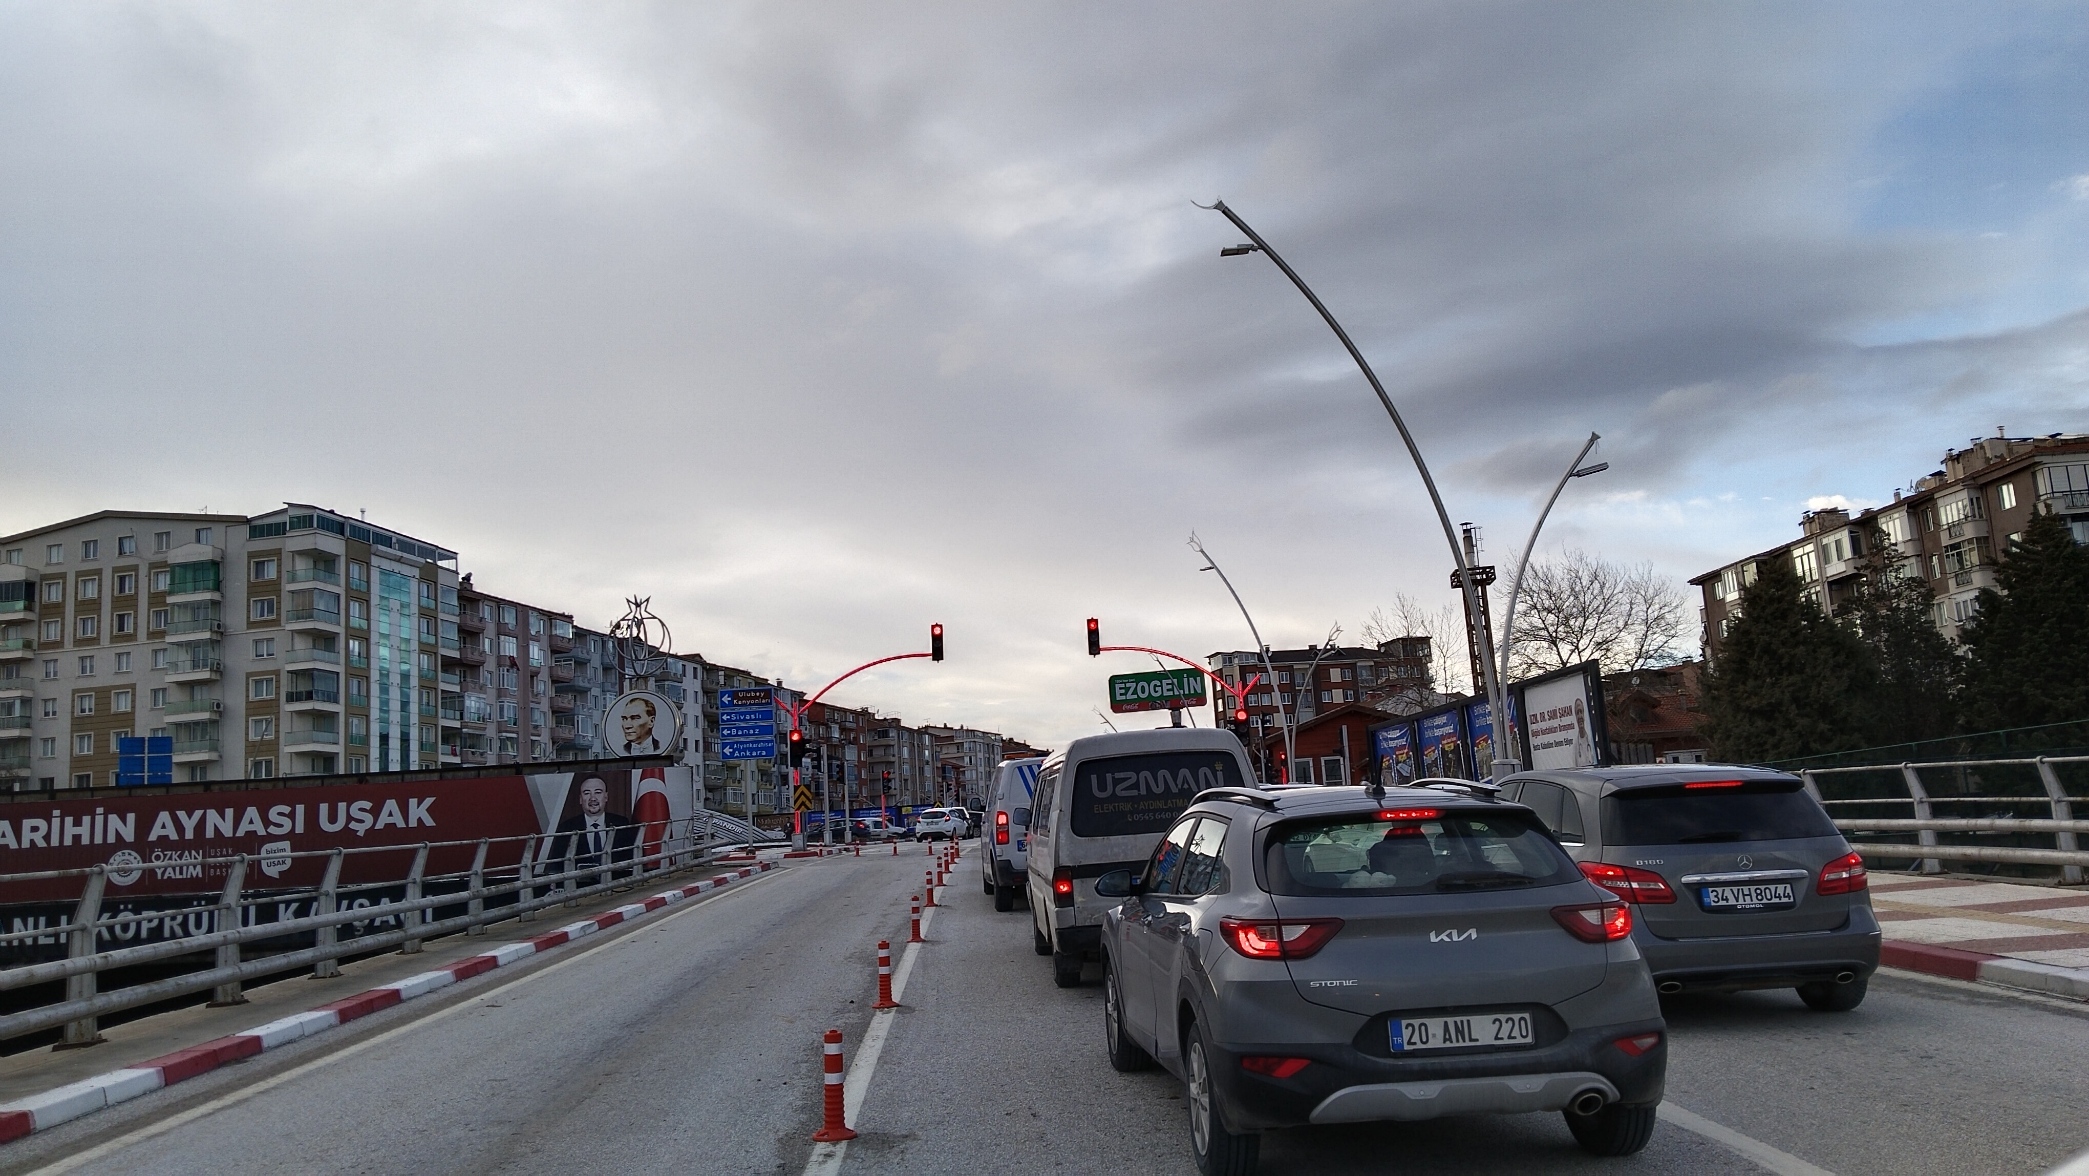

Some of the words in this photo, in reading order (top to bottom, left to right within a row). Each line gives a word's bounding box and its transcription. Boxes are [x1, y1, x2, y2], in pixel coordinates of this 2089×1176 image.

[1115, 674, 1202, 700] EZOGELİN
[1090, 767, 1225, 798] UZMAN
[0, 807, 136, 849] ARİHİN
[148, 804, 305, 841] AYNASI
[319, 797, 437, 837] UŞAK
[152, 848, 202, 863] ÖZKAN
[266, 847, 287, 855] bizim
[156, 864, 202, 880] YALIM
[1710, 889, 1730, 904] 34
[1730, 887, 1751, 902] VH
[1755, 885, 1792, 902] 8044
[1429, 928, 1478, 943] KIA
[1310, 979, 1358, 988] STONIC
[1404, 1022, 1430, 1046] 20
[1442, 1019, 1480, 1044] ANL
[1491, 1016, 1530, 1041] 220
